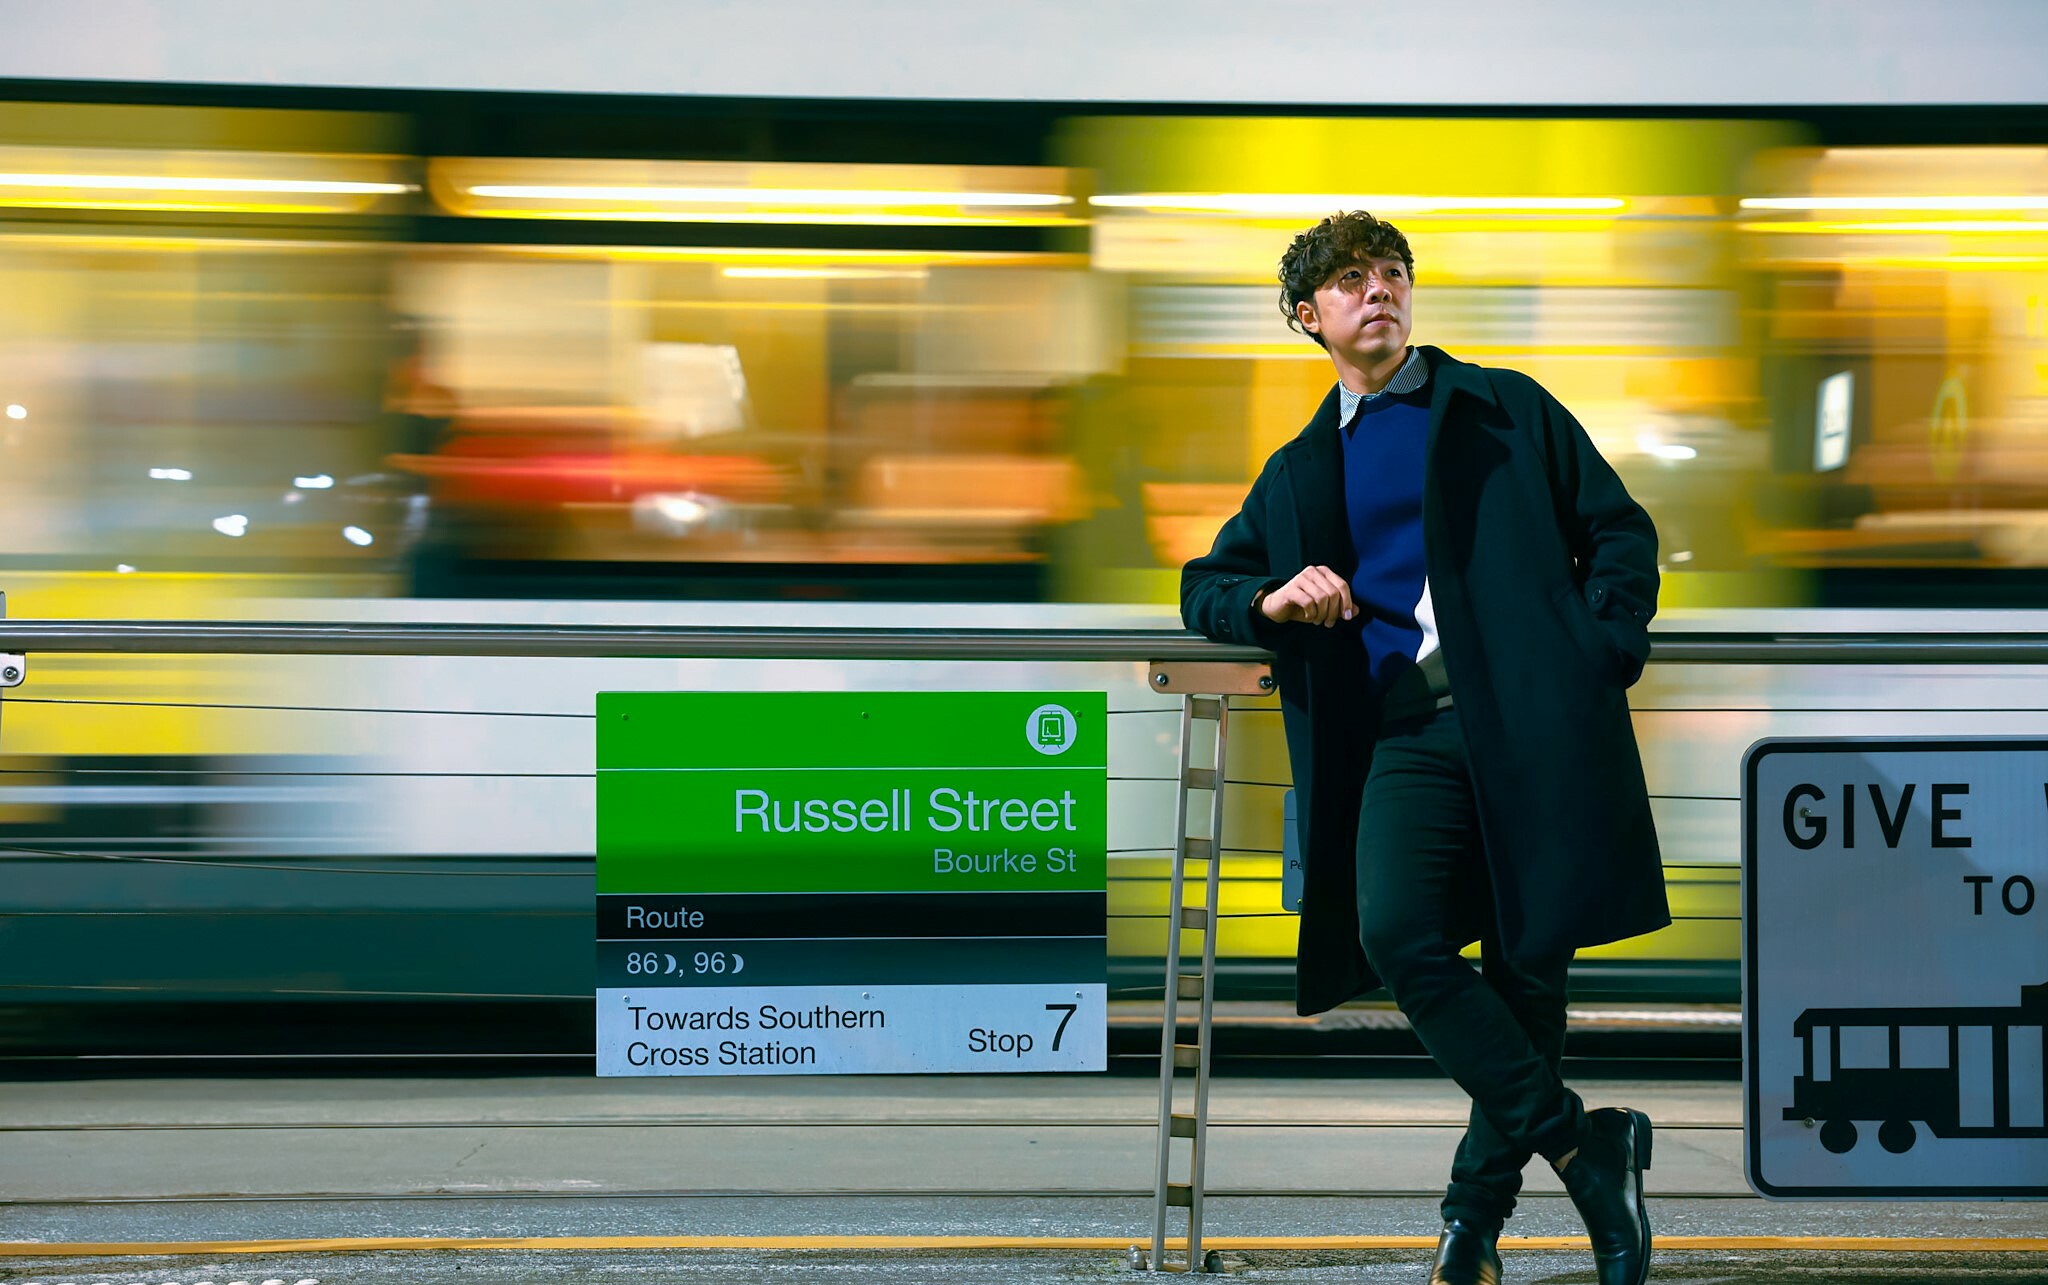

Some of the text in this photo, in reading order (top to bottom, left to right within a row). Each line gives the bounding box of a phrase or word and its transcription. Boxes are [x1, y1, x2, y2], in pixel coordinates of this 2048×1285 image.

[735, 787, 1077, 833] Russell Street
[1783, 783, 1972, 850] GIVE
[934, 847, 1077, 874] Bourke St
[1963, 874, 2035, 916] TO
[627, 906, 704, 929] Route
[627, 1004, 885, 1031] Towards Southern
[968, 1003, 1077, 1057] Stop 7
[627, 1040, 816, 1067] Cross Station
